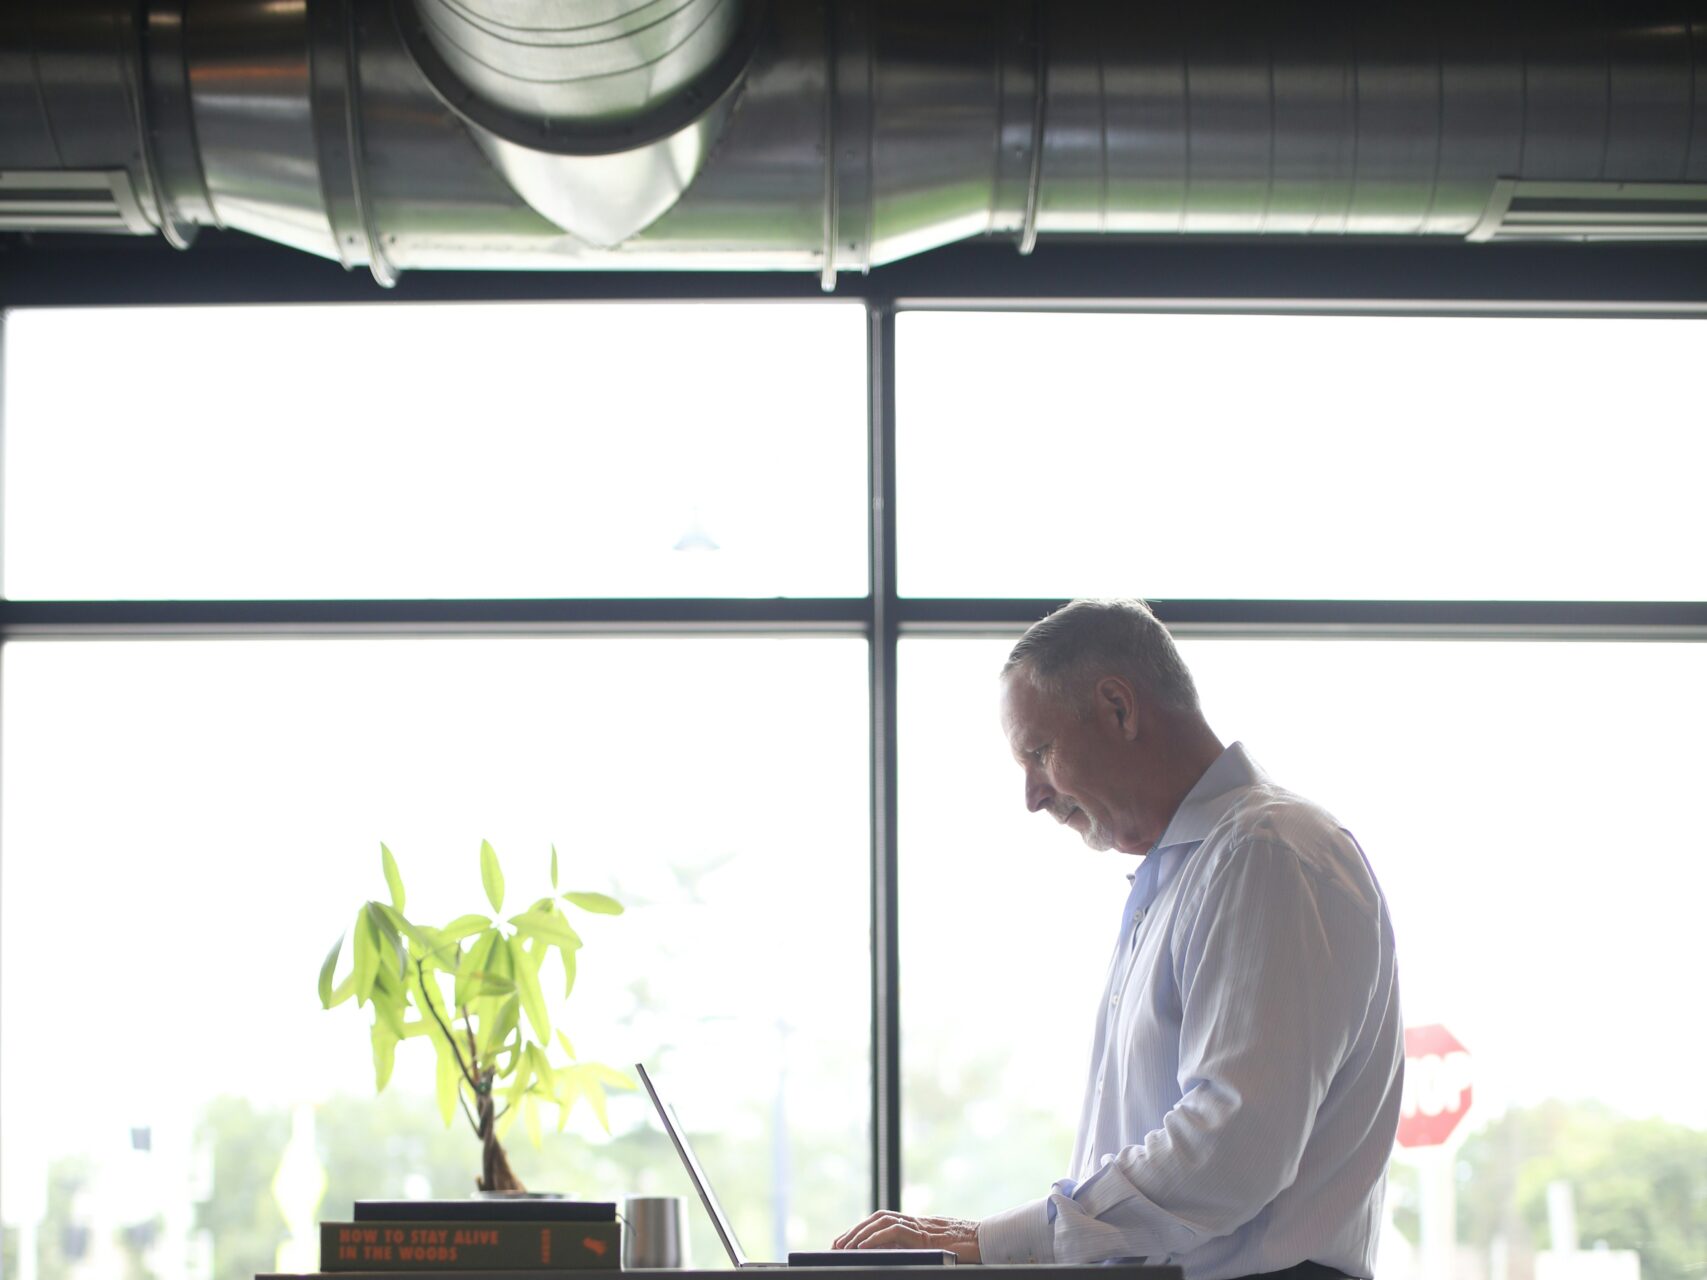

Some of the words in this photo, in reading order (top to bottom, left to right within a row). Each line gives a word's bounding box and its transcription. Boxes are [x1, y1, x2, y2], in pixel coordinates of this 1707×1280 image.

[1402, 1051, 1471, 1118] TOP
[339, 1229, 377, 1244] HOW
[384, 1229, 405, 1244] TO
[411, 1229, 448, 1245] STAY
[454, 1230, 499, 1246] ALIVE
[339, 1246, 358, 1261] IN
[364, 1246, 393, 1261] THE
[399, 1246, 459, 1262] WOODS
